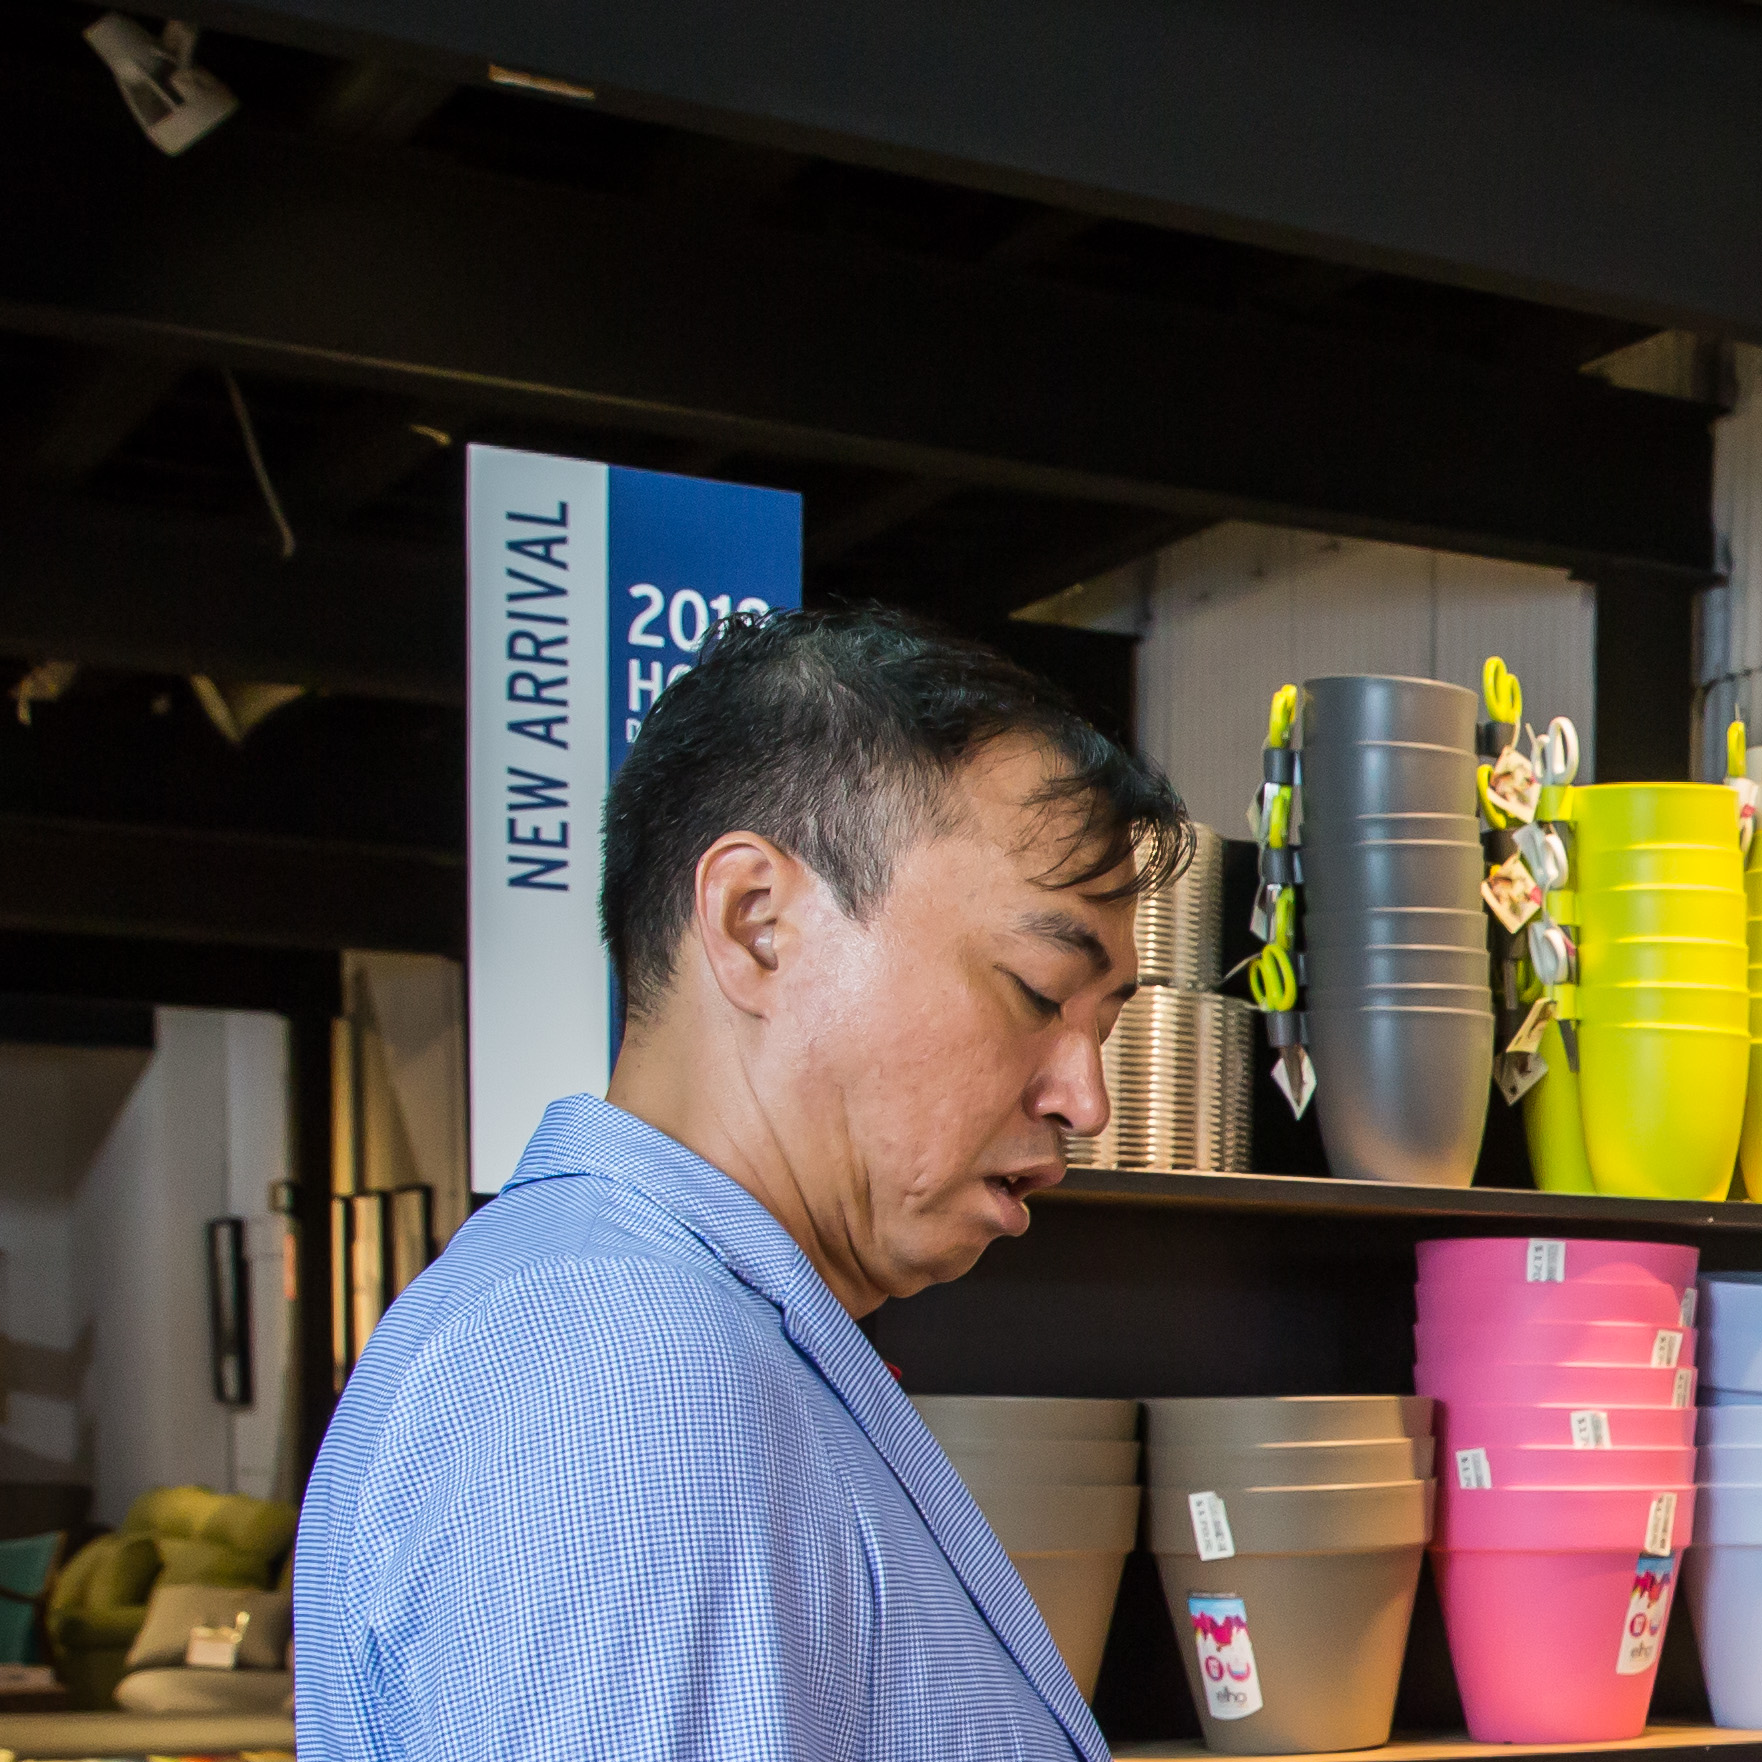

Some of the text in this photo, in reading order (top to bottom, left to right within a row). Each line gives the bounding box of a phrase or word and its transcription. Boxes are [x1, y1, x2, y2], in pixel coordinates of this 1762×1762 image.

[506, 500, 570, 892] NEW ARRIVAL
[628, 583, 771, 653] 201
